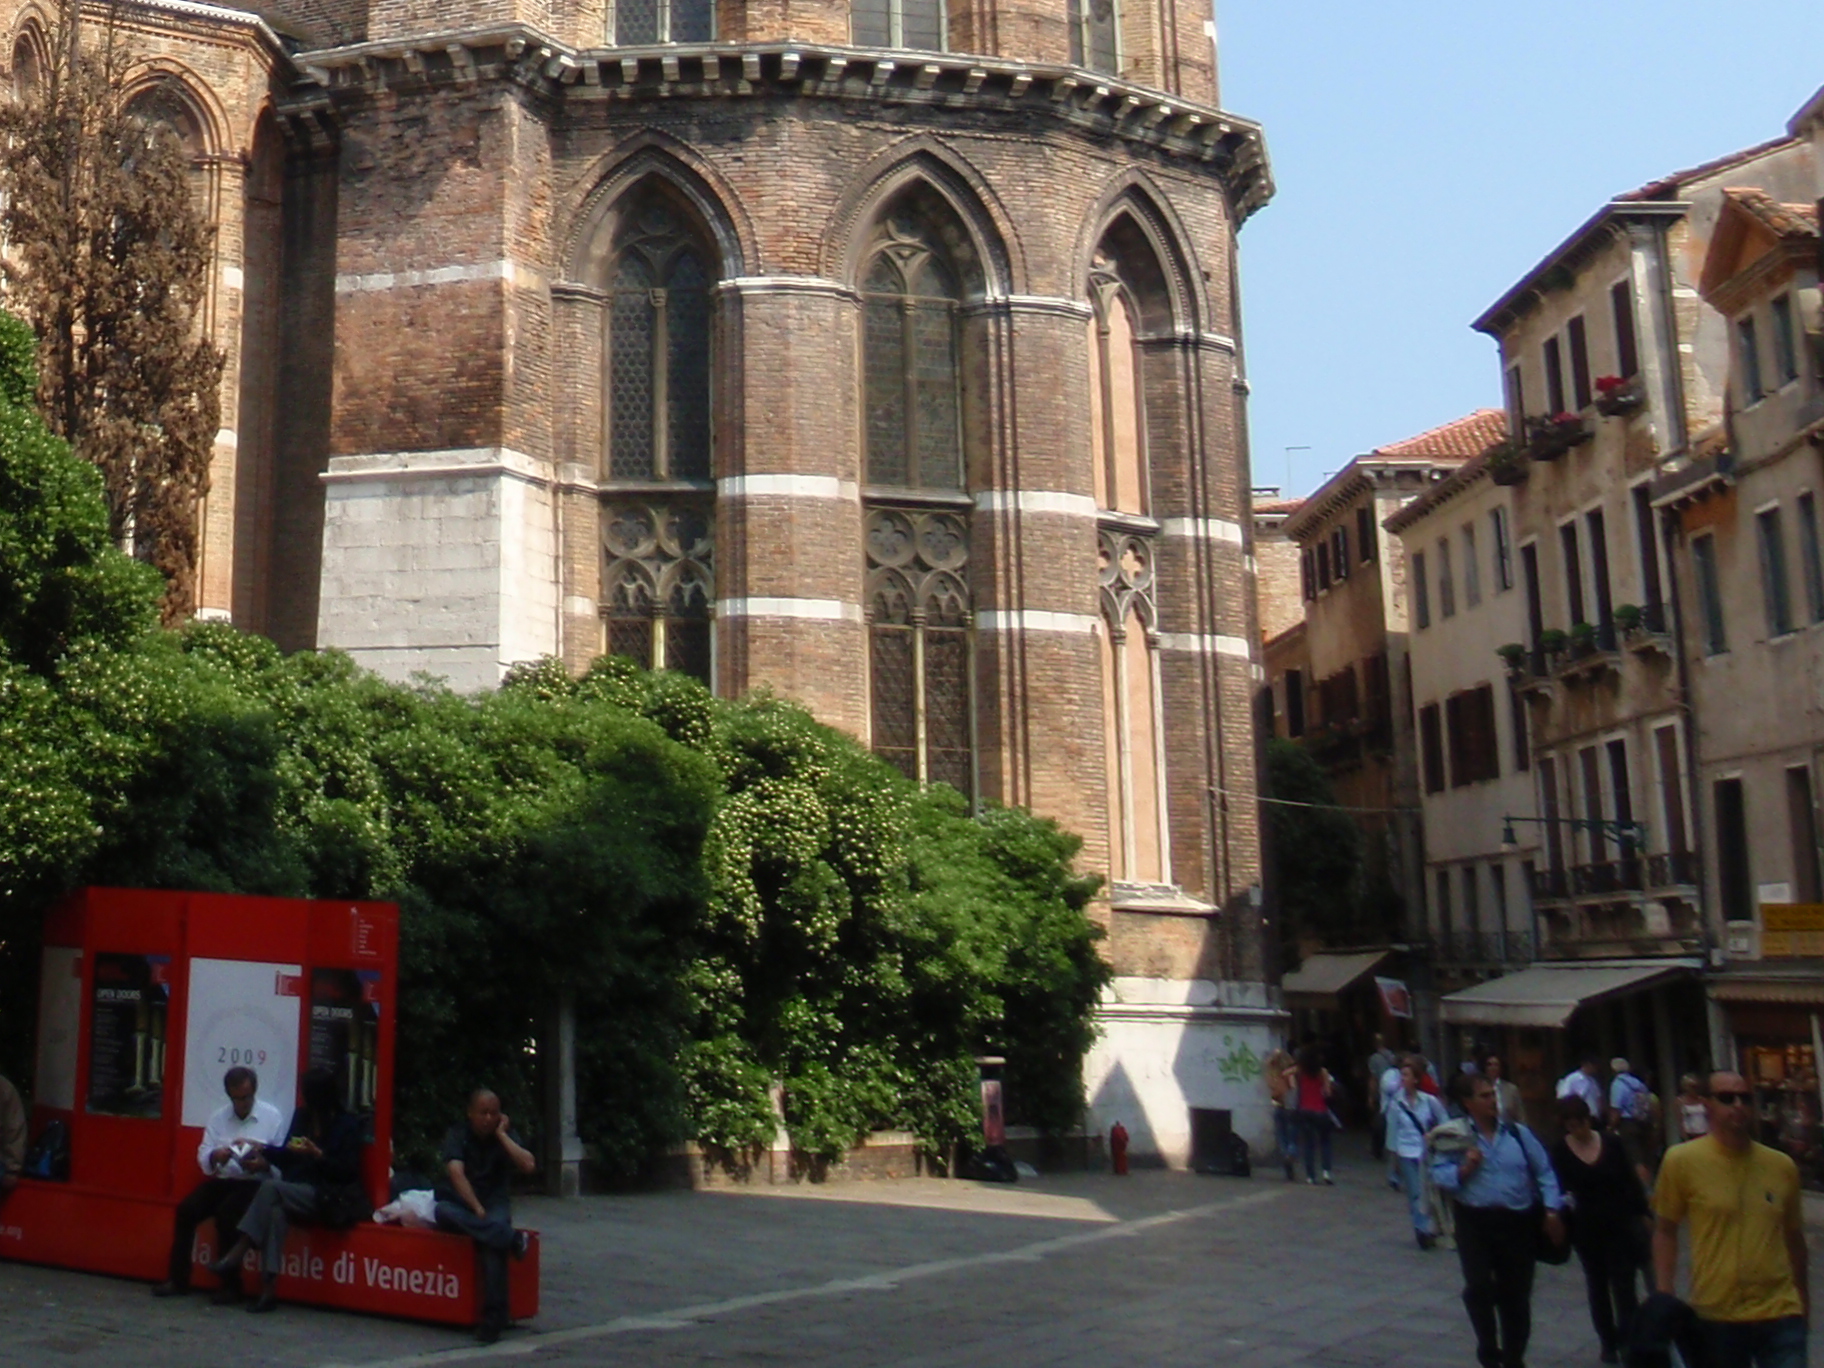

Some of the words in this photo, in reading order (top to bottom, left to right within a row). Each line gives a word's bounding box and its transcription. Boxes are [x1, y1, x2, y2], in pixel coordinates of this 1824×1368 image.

[217, 1046, 267, 1065] 2009
[191, 1234, 212, 1266] la
[332, 1250, 356, 1284] di
[363, 1256, 461, 1299] Venezia
